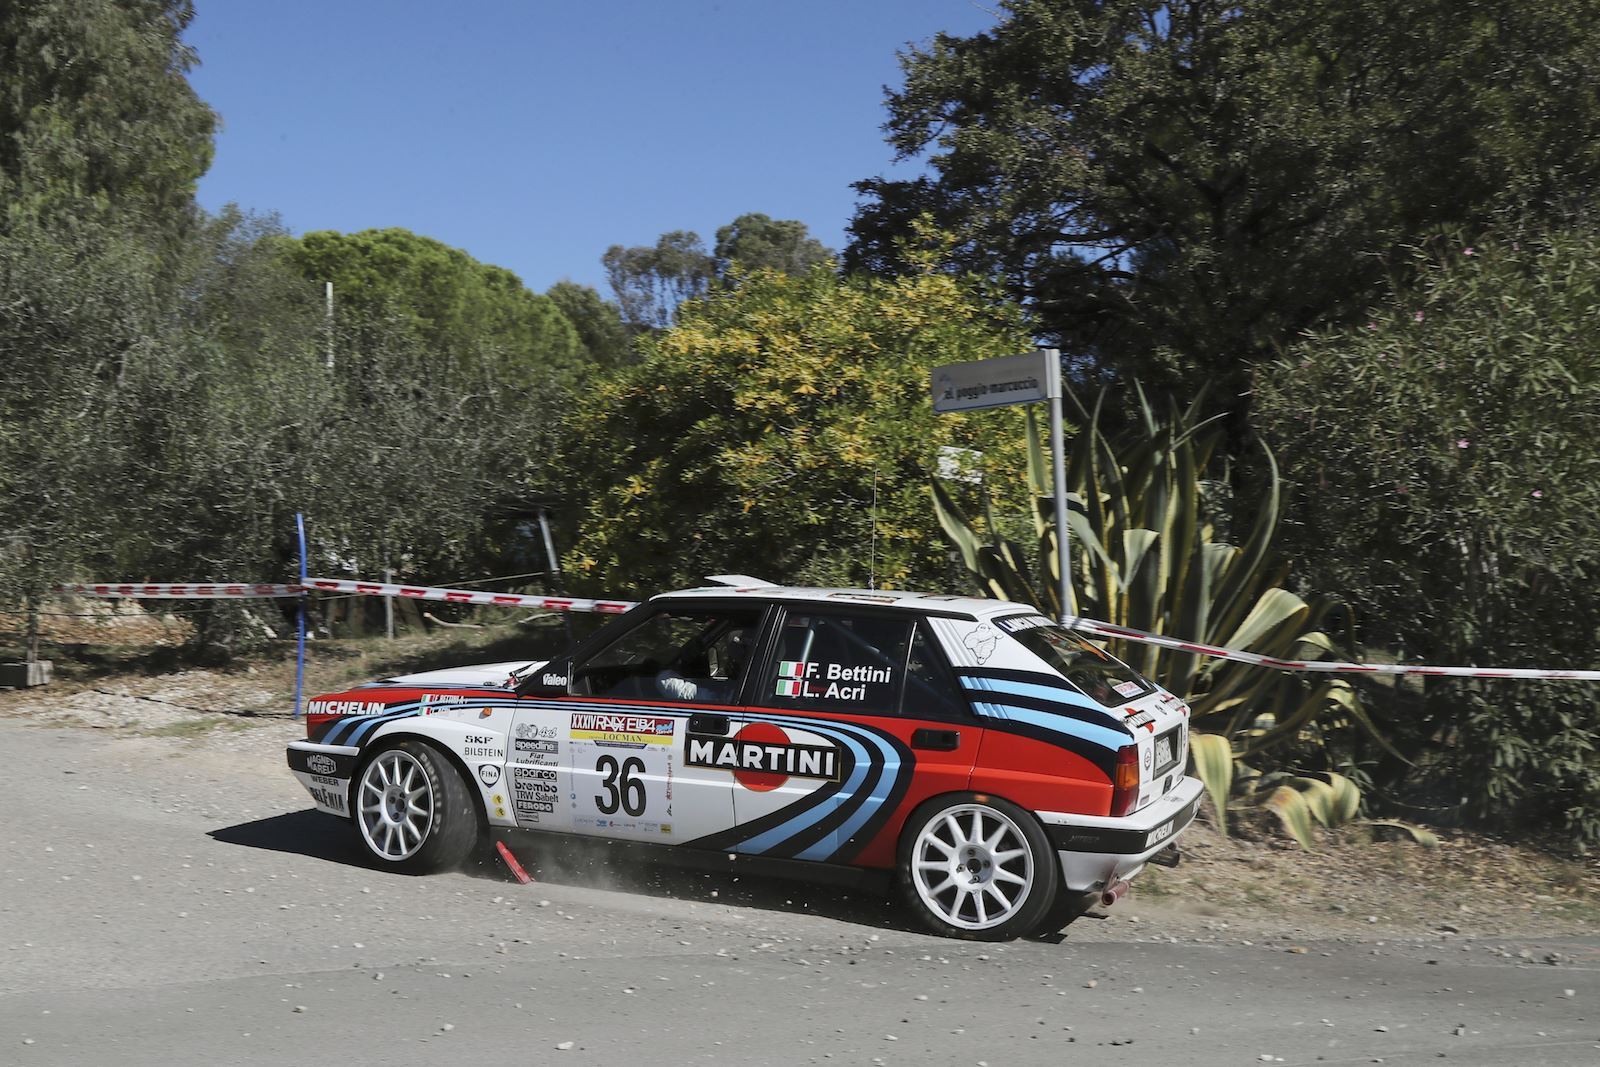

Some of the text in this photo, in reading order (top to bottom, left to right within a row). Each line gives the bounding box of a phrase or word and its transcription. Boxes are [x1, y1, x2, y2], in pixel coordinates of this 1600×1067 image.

[806, 662, 892, 683] F. Bettini
[542, 673, 567, 686] Valeo
[802, 682, 866, 700] L. Acri
[308, 701, 385, 715] MICHELIN
[464, 735, 493, 744] SKF
[603, 733, 642, 742] LOCMAN
[464, 747, 503, 757] BILSTEIN
[690, 739, 834, 776] MARTINI
[516, 758, 559, 767] Lubrificanti
[481, 770, 498, 778] FINA
[515, 768, 557, 779] sparco
[310, 775, 339, 786] WEBER
[594, 755, 647, 817] 36
[515, 781, 557, 793] brembo
[515, 790, 559, 803] TRW Sabelt
[518, 801, 552, 812] FERODO
